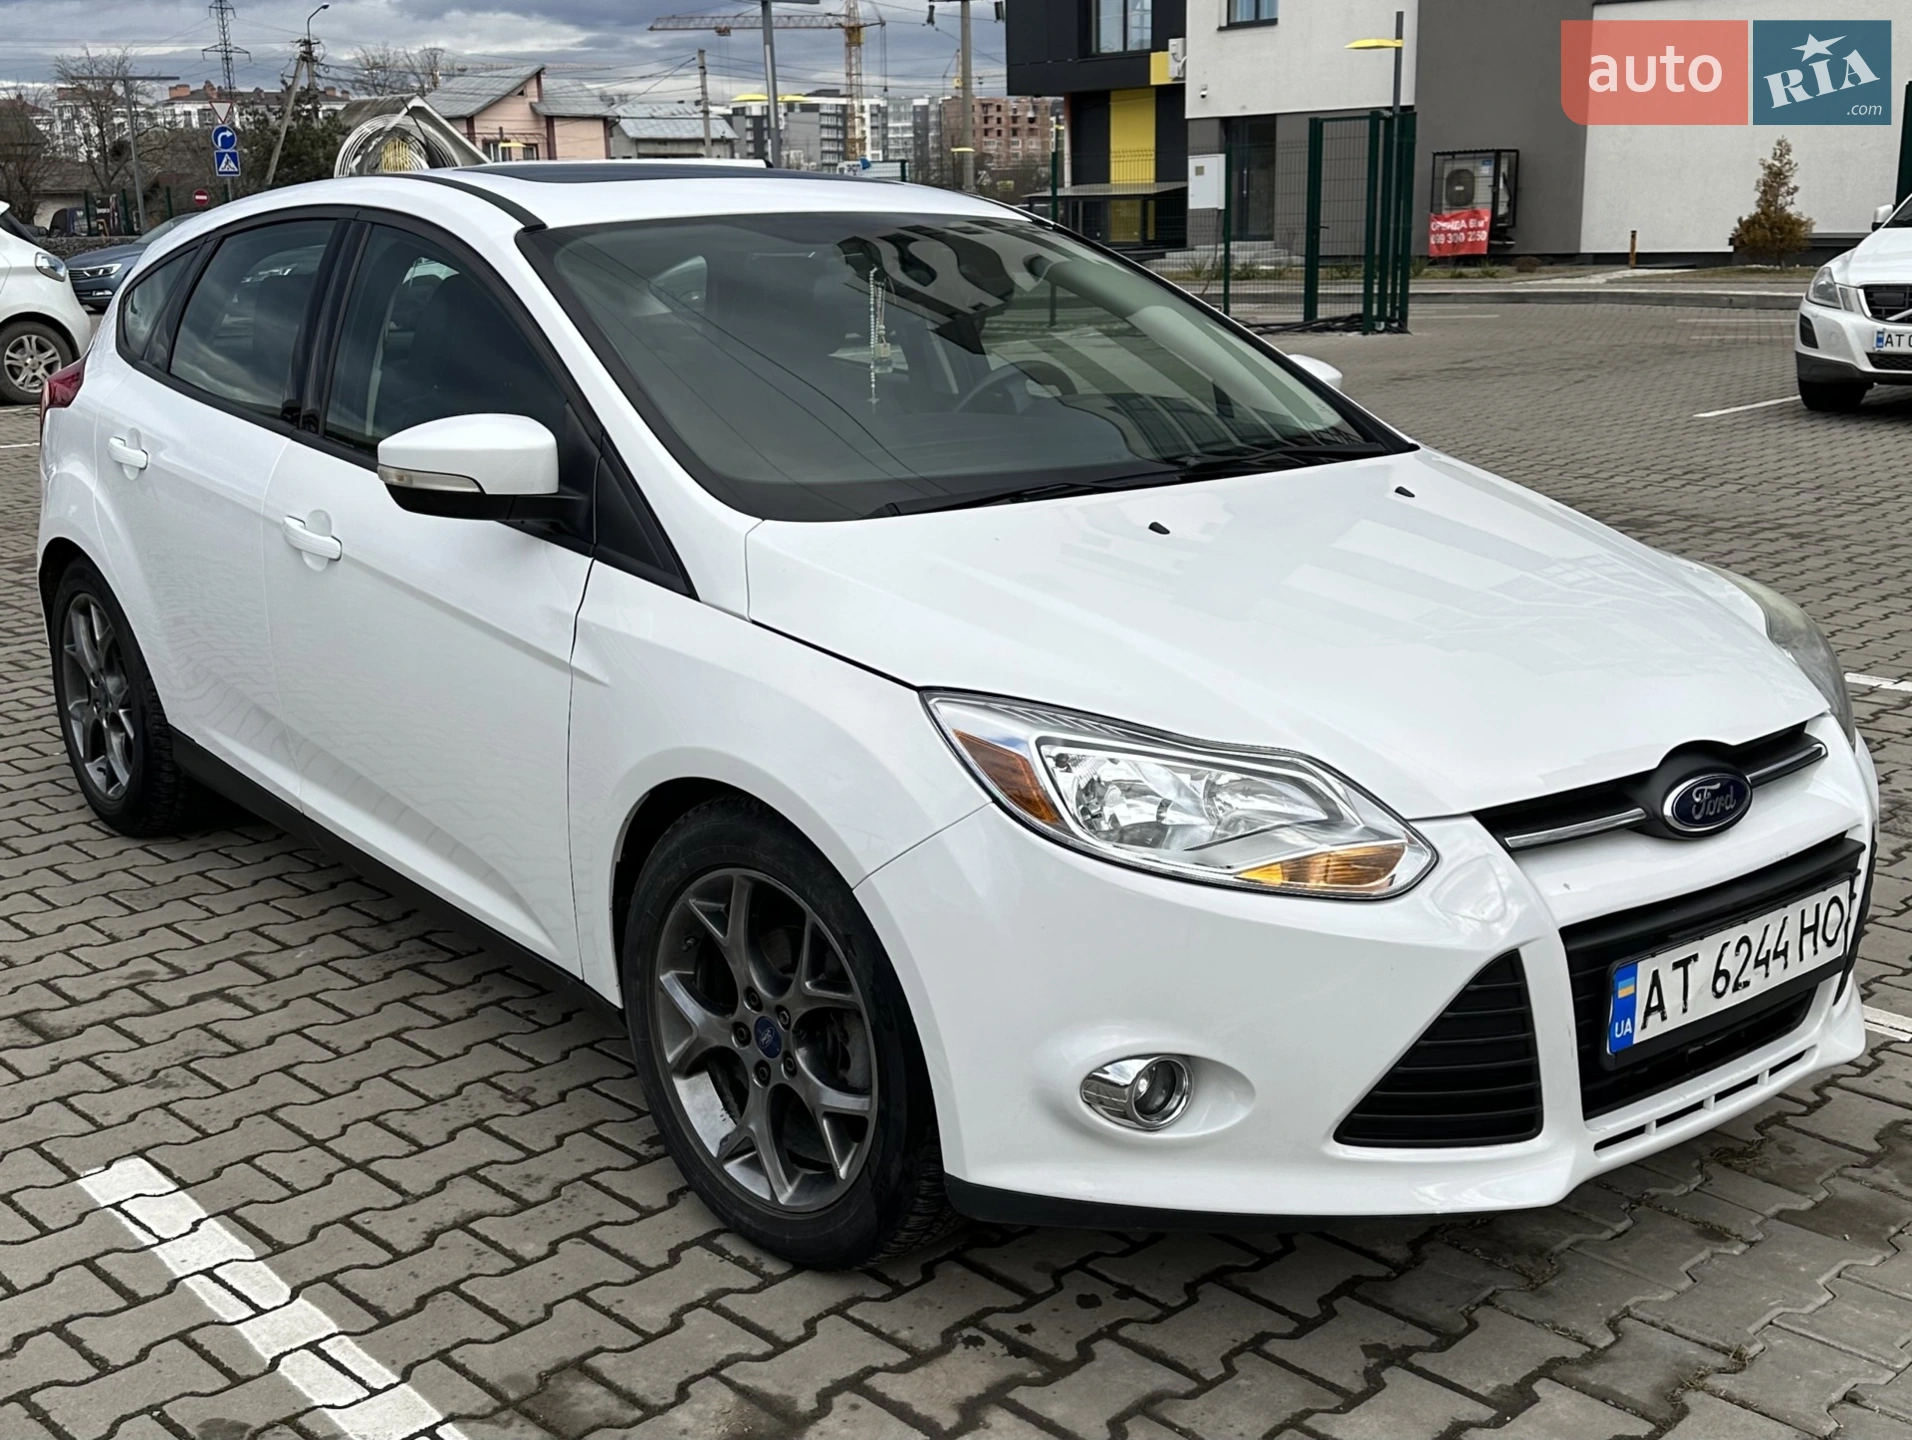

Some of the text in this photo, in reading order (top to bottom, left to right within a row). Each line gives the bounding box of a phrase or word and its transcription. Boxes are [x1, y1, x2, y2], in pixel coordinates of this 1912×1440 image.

[1885, 333, 1905, 347] AT
[1691, 782, 1737, 820] Ford
[1640, 895, 1845, 1031] AT 6244 HO
[1615, 1018, 1632, 1038] UA
